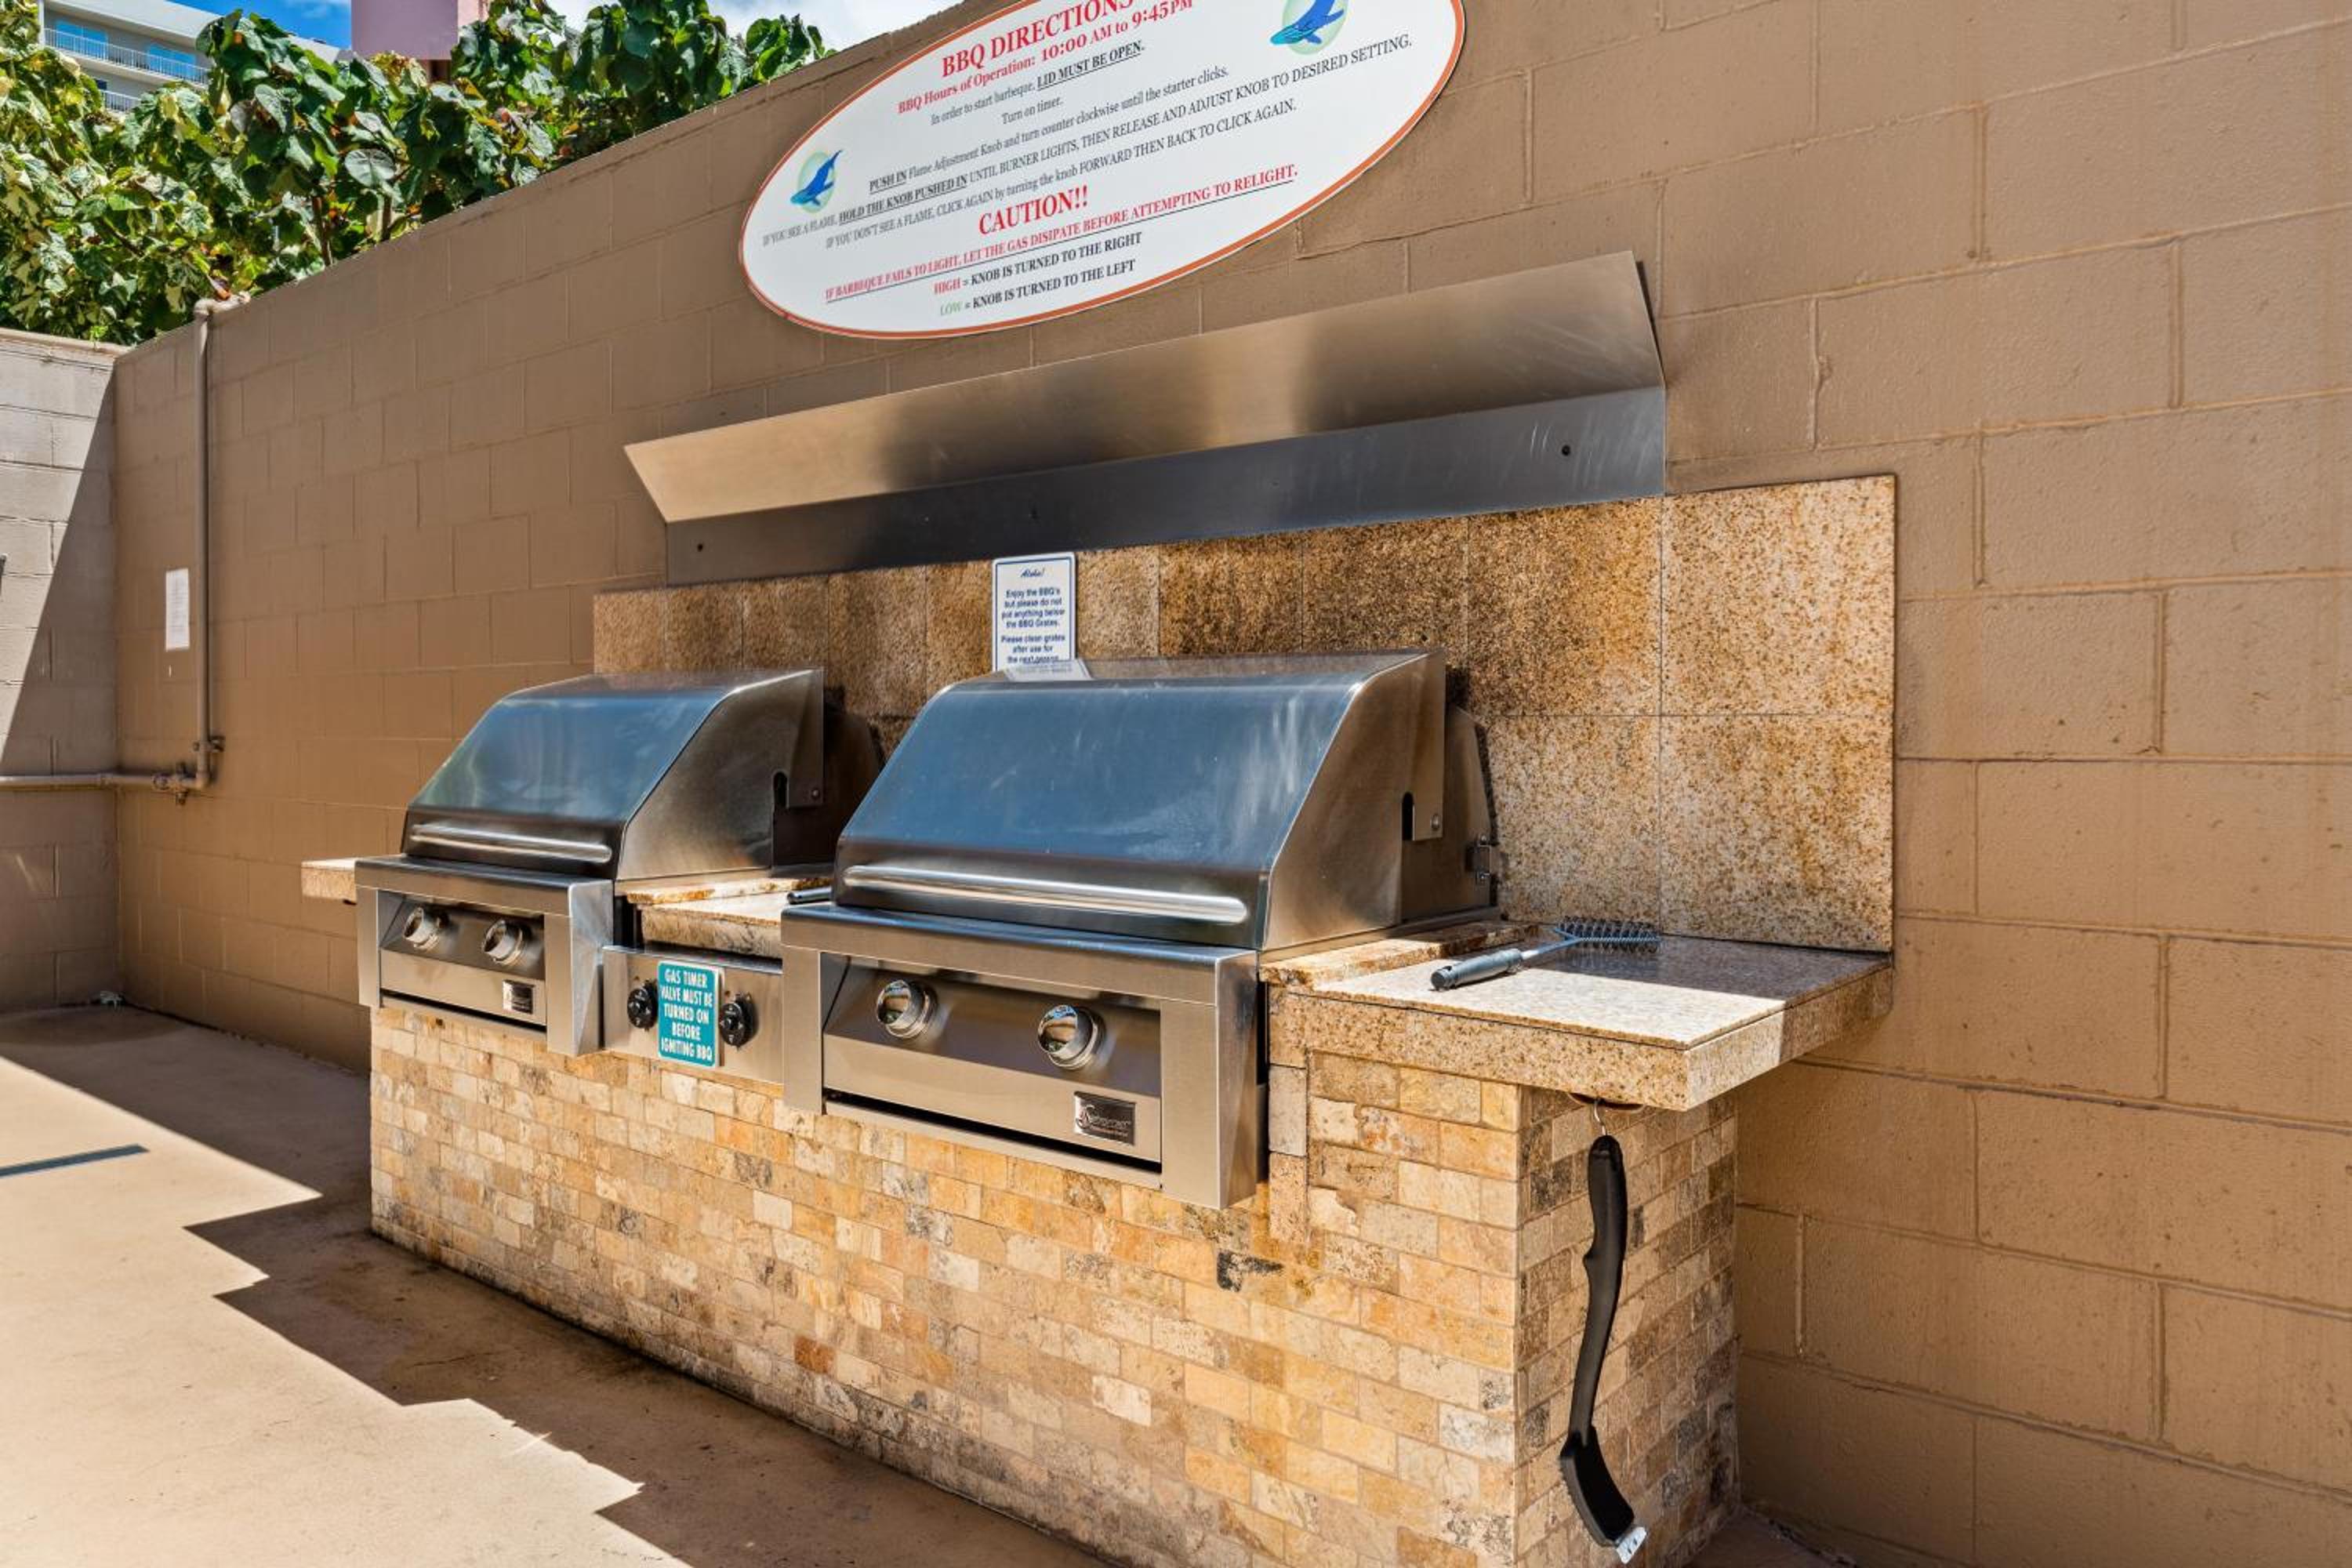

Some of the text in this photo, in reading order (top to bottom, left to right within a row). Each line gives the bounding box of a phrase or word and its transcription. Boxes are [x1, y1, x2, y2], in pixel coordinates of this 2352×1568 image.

[898, 96, 922, 114] BBQ
[924, 85, 957, 104] Hours
[960, 76, 973, 92] of
[974, 56, 1036, 87] Operation:
[1042, 34, 1087, 62] 10:00
[1091, 24, 1112, 44] AM
[1116, 21, 1128, 34] to
[942, 43, 985, 78] BBQ
[931, 114, 940, 125] In
[941, 106, 963, 121] order
[964, 103, 973, 114] to
[974, 96, 993, 110] start
[1037, 71, 1057, 89] LID
[1058, 59, 1091, 78] MUST
[1092, 53, 1108, 68] BE
[1109, 40, 1145, 62] OPEN.
[1001, 96, 1063, 124] Turn on timer.
[788, 227, 800, 238] SEE
[839, 205, 864, 223] HOLD
[866, 201, 884, 216] THE
[886, 191, 913, 208] KNOB
[916, 178, 954, 200] PUSHED
[956, 173, 967, 187] IN
[969, 165, 998, 183] UNTIL
[1000, 151, 1039, 174] BURNER
[1040, 139, 1080, 162] LIGHTS,
[1080, 128, 1111, 148] THEN
[1112, 112, 1161, 139] RELEASE
[1162, 104, 1187, 124] AND
[1188, 89, 1234, 114] ADJUST
[1235, 79, 1270, 101] KNOB
[1272, 72, 1290, 89] TO
[1292, 54, 1349, 82] DESIRED
[1350, 34, 1412, 64] SETTING.
[869, 66, 1229, 191] PUSH IN Flame Adjustment Knob and turn counter clockwise until the starter clicks.
[826, 237, 834, 249] IF
[835, 232, 852, 247] YOU
[880, 220, 896, 233] SEE
[896, 217, 902, 228] A
[936, 198, 965, 216] CLICK
[965, 190, 993, 209] AGAIN
[995, 187, 1004, 201] by
[1006, 178, 1039, 196] turning
[1039, 172, 1054, 186] the
[1055, 164, 1078, 181] knob
[1080, 147, 1133, 174] FORWARD
[1134, 137, 1165, 158] THEN
[1167, 126, 1197, 149] BACK
[1198, 122, 1215, 139] TO
[1216, 111, 1253, 133] CLICK
[1254, 98, 1297, 122] AGAIN.
[979, 185, 1087, 235] CAUTION!!
[826, 288, 834, 299] IF
[835, 275, 884, 296] BARBEQUE
[885, 268, 912, 284] FAILS
[913, 263, 927, 276] TO
[964, 249, 982, 263] LET
[984, 241, 1005, 259] THE
[1007, 237, 1029, 252] GAS
[1031, 222, 1082, 246] DISIPATE
[1083, 209, 1129, 231] BEFORE
[1131, 188, 1211, 220] ATTEMPTING
[1214, 181, 1231, 196] TO
[1235, 165, 1298, 191] RELIGHT.
[934, 278, 961, 294] HIGH
[971, 267, 1000, 285] KNOB
[1002, 265, 1013, 277] IS
[1014, 253, 1059, 274] TURNED
[1061, 249, 1076, 263] TO
[1078, 242, 1103, 258] THE
[1105, 232, 1142, 252] RIGHT
[941, 302, 963, 316] LOW
[973, 290, 1002, 309] KNOB
[1004, 288, 1014, 300] IS
[1015, 278, 1062, 298] TURNED
[1063, 271, 1078, 285] TO
[1080, 267, 1104, 282] THE
[1106, 259, 1136, 277] LEFT
[1006, 589, 1025, 599] Enjoy
[1017, 600, 1039, 608] please
[1050, 597, 1062, 605] not
[1001, 612, 1012, 620] put
[1014, 610, 1044, 619] anything
[1018, 619, 1034, 628] BBQ
[1044, 633, 1065, 644] grates
[665, 968, 708, 988] GAS TIMER
[661, 985, 713, 1008] VALVE MUST BE
[664, 1004, 710, 1025] TURNED ON
[672, 1022, 701, 1041] BEFORE
[661, 1036, 713, 1062] IGNITING BBQ
